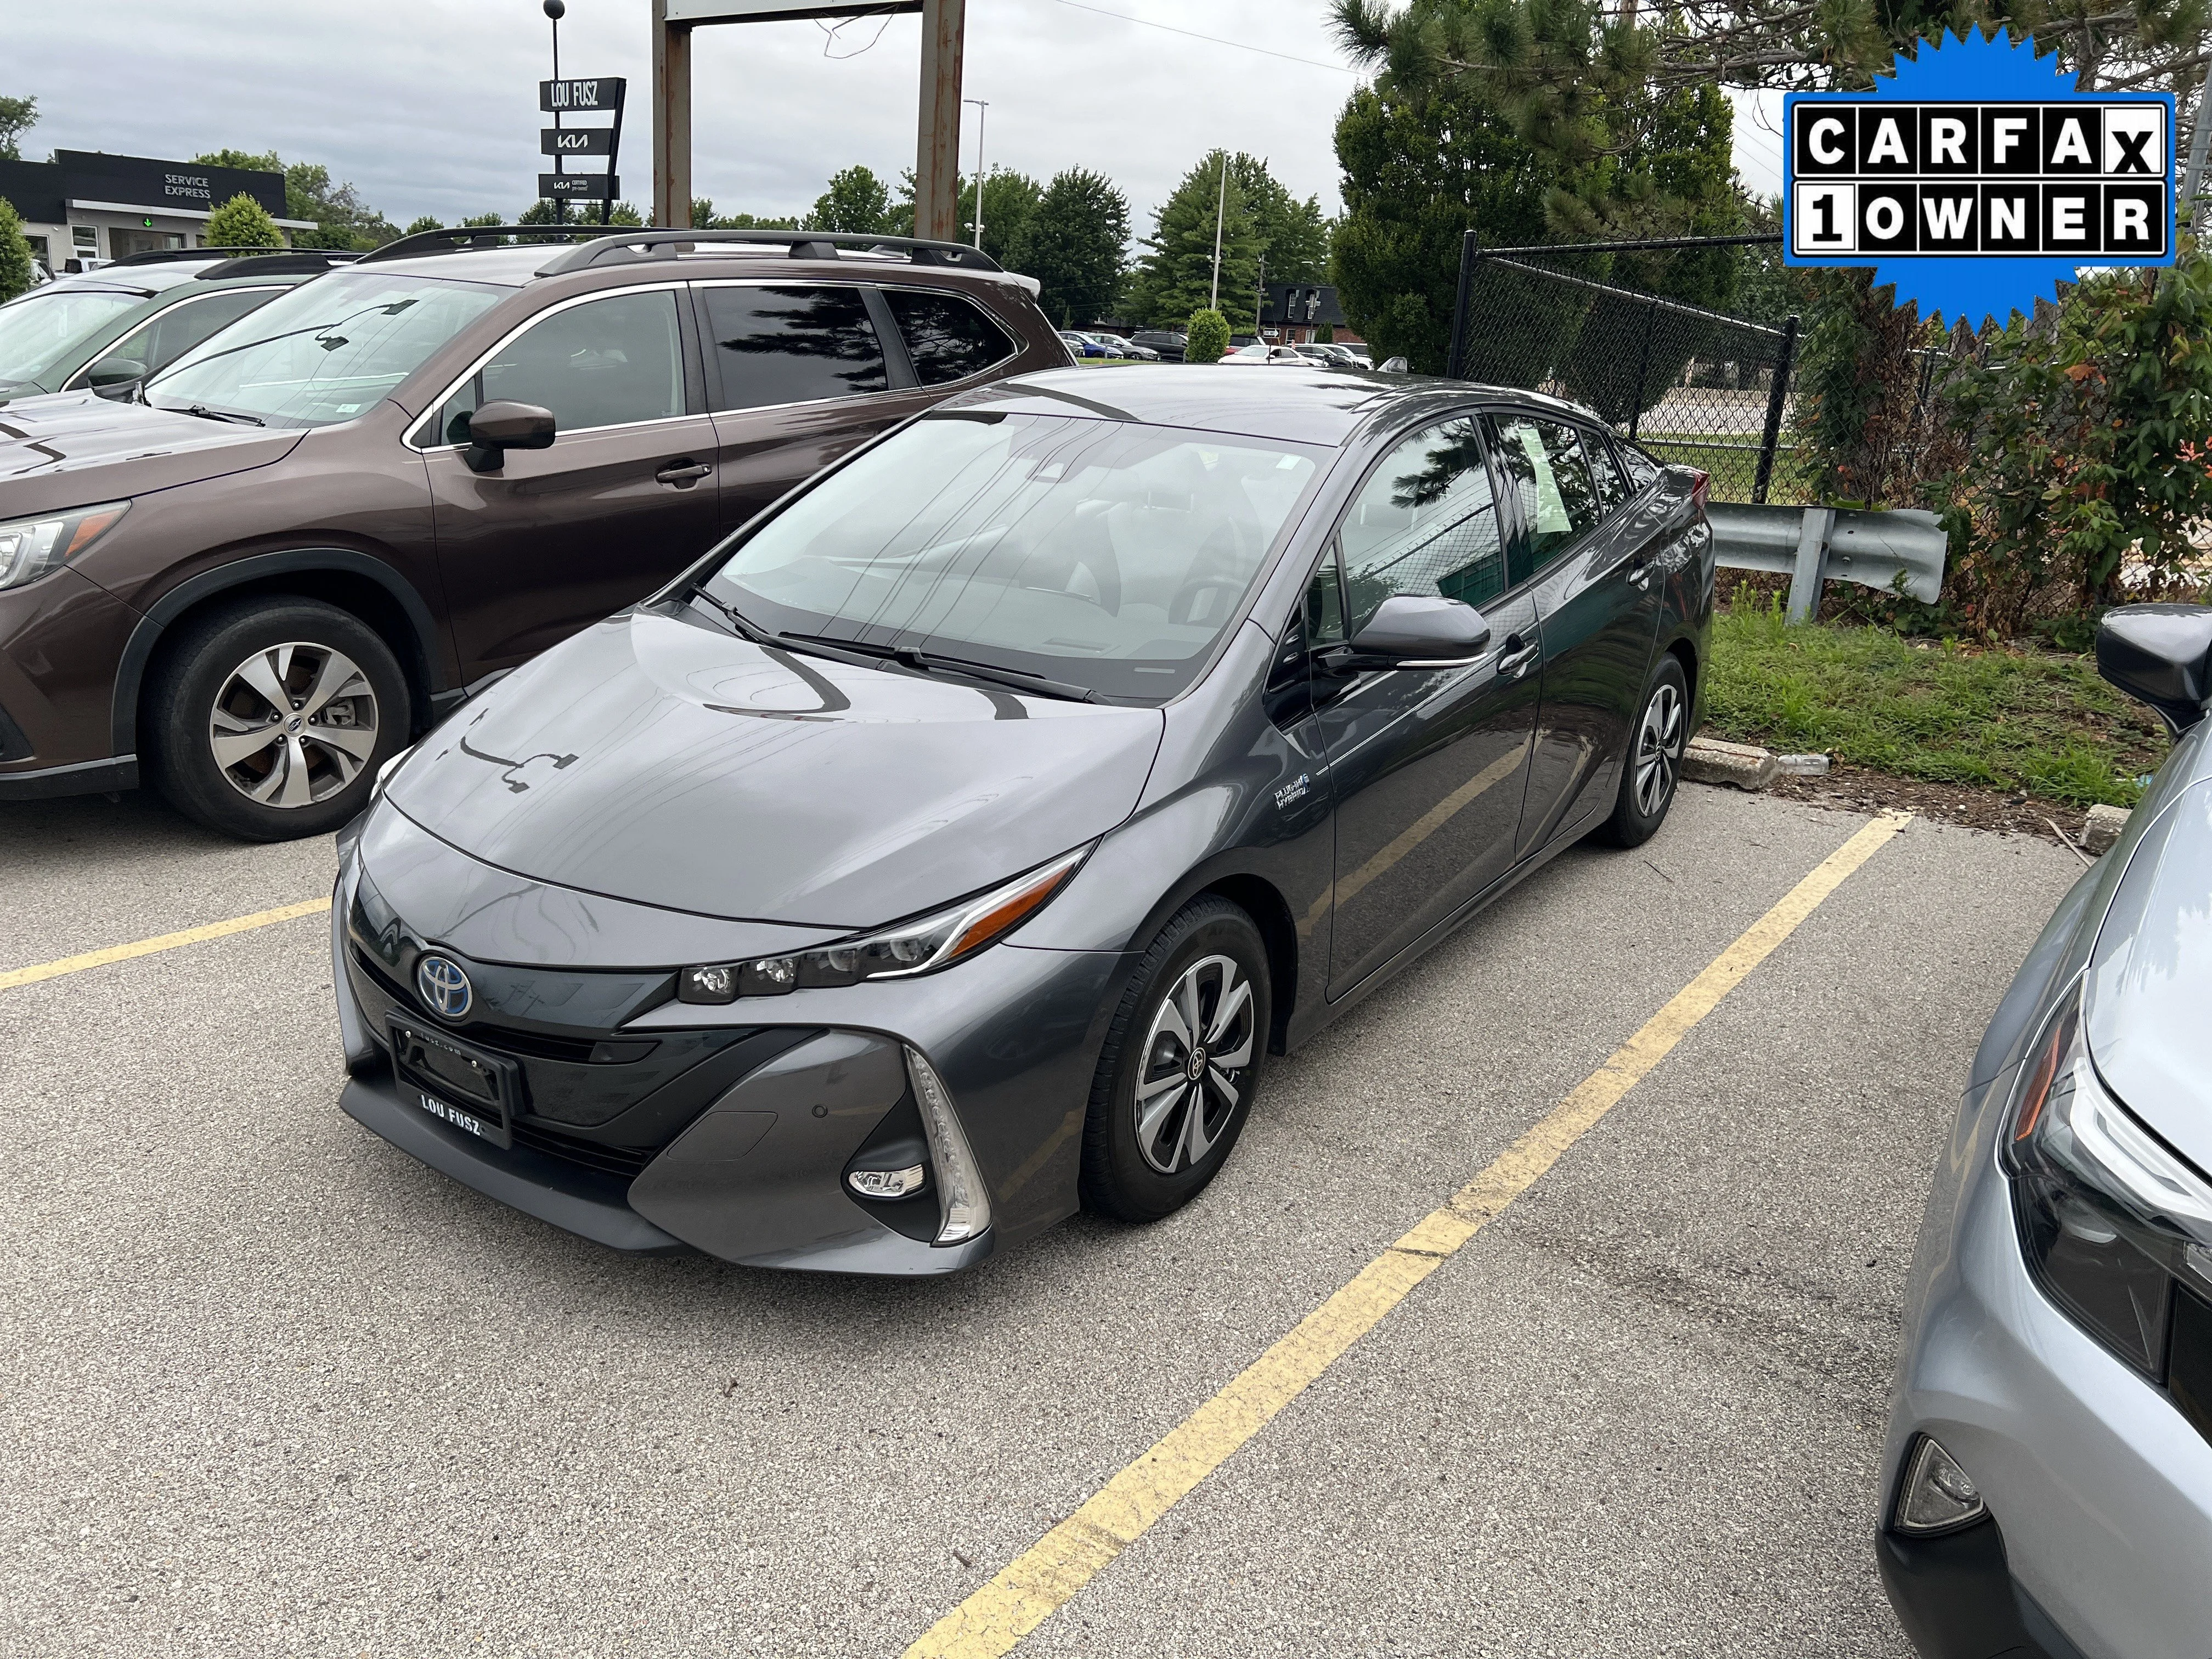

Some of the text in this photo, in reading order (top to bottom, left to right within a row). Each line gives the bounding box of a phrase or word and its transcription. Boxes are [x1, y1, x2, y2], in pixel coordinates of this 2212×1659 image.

[551, 81, 598, 107] LOU FUSZ
[165, 174, 209, 187] SERVICE
[165, 185, 211, 199] EXPRESS
[421, 1094, 481, 1136] LOU FUSZ
